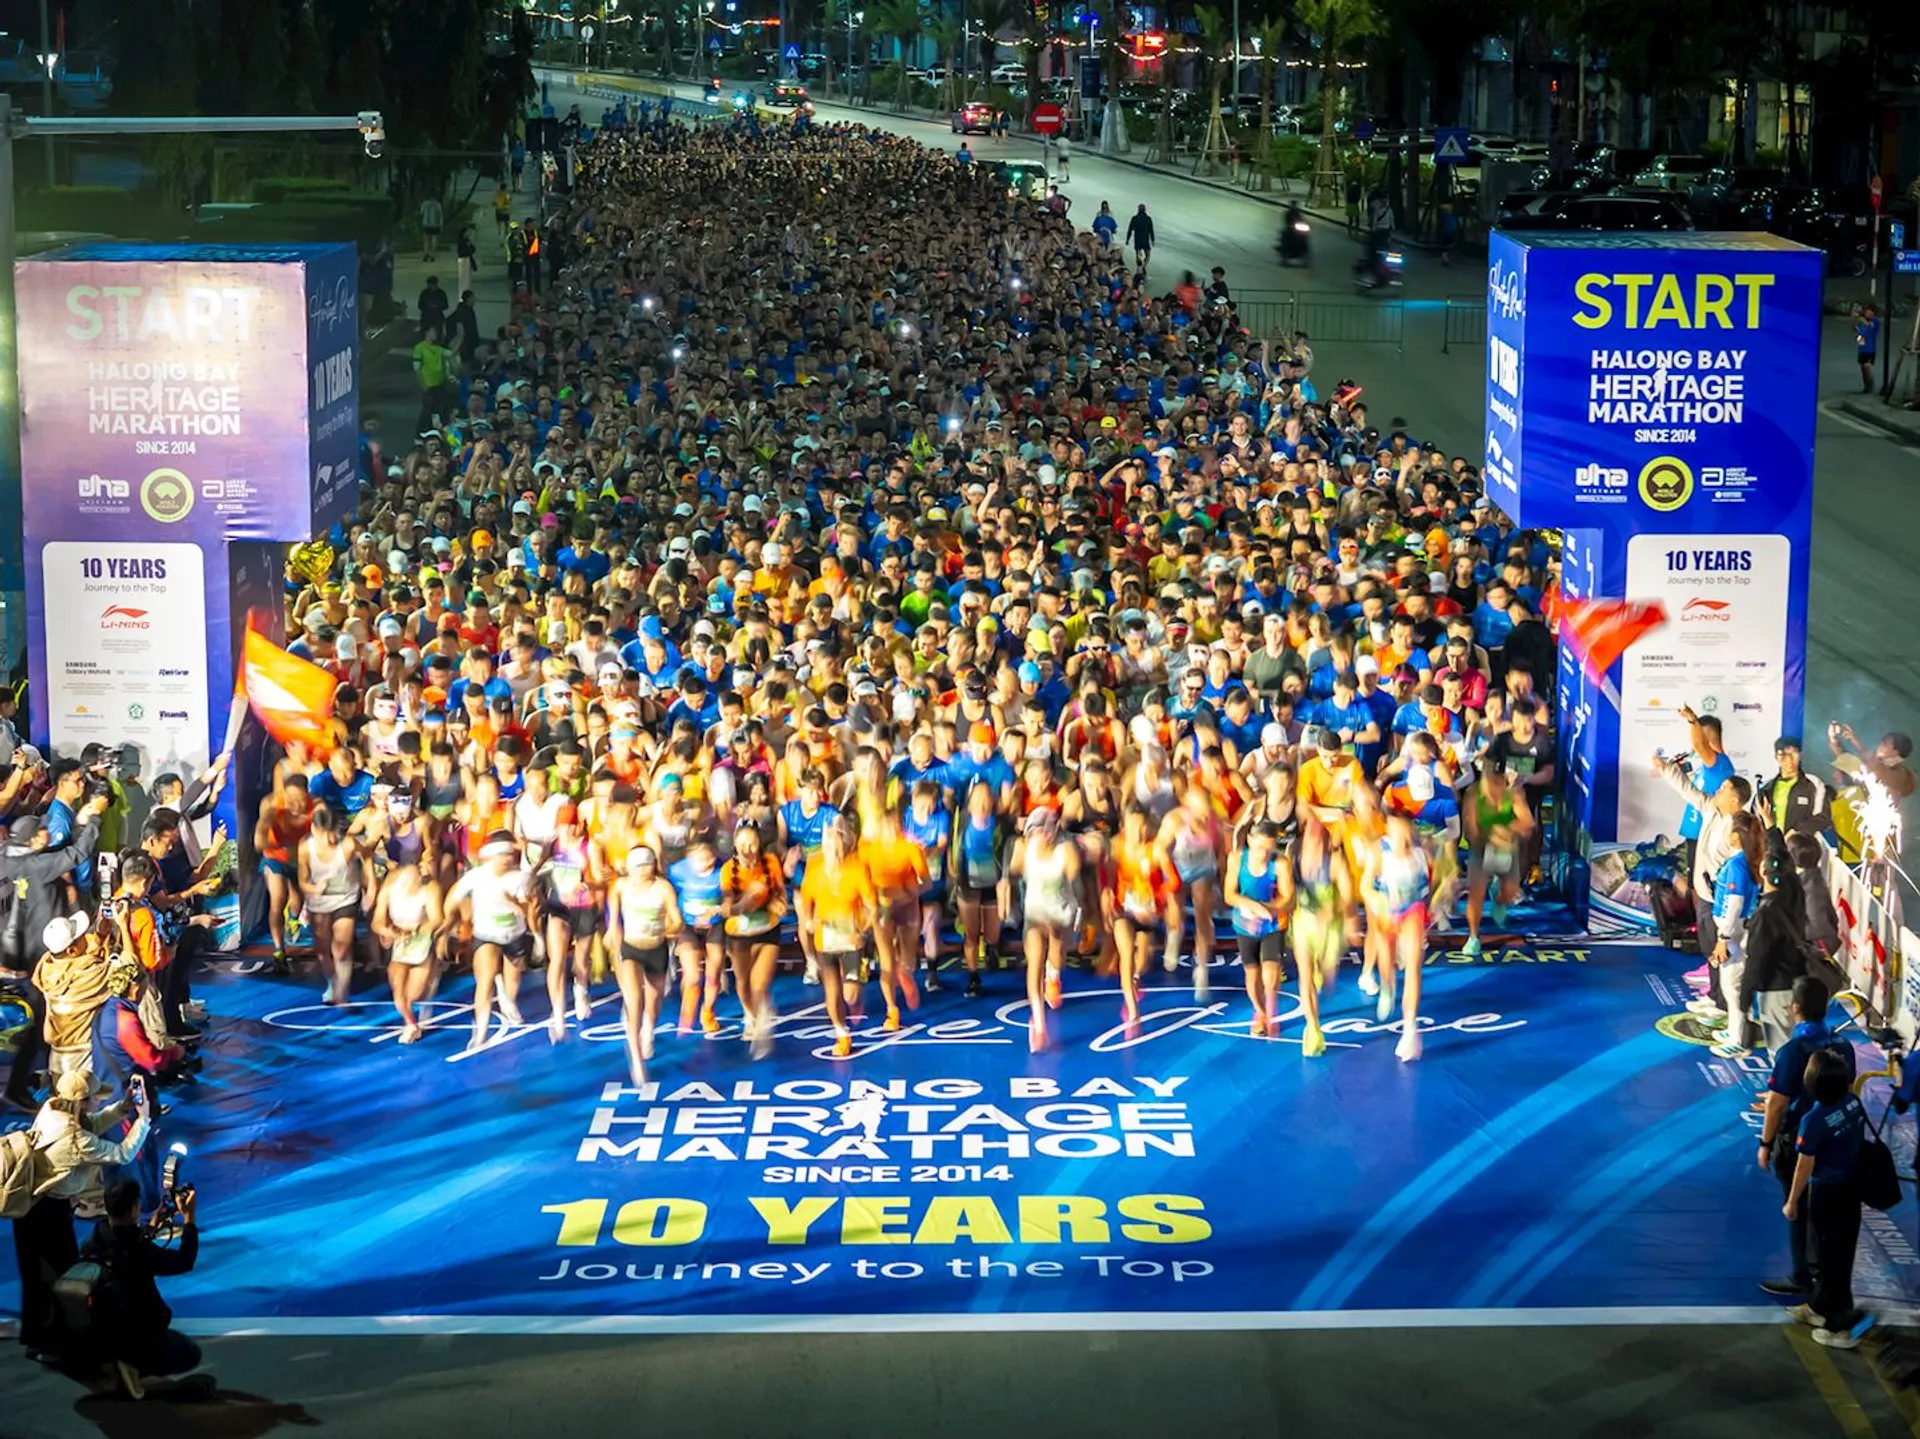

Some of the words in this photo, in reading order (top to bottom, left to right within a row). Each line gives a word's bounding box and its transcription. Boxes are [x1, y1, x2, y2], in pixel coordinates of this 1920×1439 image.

[1572, 272, 1775, 329] START
[65, 285, 262, 341] START
[1591, 350, 1692, 369] HALONG
[1698, 350, 1747, 369] BAY
[89, 362, 187, 381] HALONG
[195, 362, 240, 381] BAY
[1590, 374, 1744, 400] HERITAGE
[89, 386, 241, 412] HERITAGE
[1589, 401, 1743, 424] MARATHON
[89, 413, 241, 435] MARATHON
[1634, 429, 1669, 443] SINCE
[1670, 429, 1696, 443] 2014
[136, 441, 168, 454] SINCE
[169, 441, 196, 454] 2014
[80, 558, 103, 578] 10
[108, 558, 166, 579] YEARS
[1666, 551, 1687, 571] 10
[1693, 550, 1752, 571] YEARS
[83, 583, 119, 593] Journey
[121, 584, 131, 592] to
[133, 583, 148, 592] the
[150, 584, 166, 593] Top
[1667, 576, 1703, 586] Journey
[1717, 575, 1732, 584] the
[1733, 576, 1751, 586] Top
[101, 621, 149, 629] LI-NING
[600, 1078, 983, 1102] HALONG
[1009, 1076, 1190, 1098] BAY
[587, 1103, 1194, 1135] HERITAGE
[576, 1133, 1196, 1162] MARATHON
[762, 1166, 903, 1184] SINCE
[910, 1165, 1014, 1183] 2014
[540, 1198, 708, 1248] 10
[748, 1194, 1213, 1246] YEARS
[538, 1258, 831, 1284] Journey
[851, 1260, 919, 1279] to
[945, 1256, 1048, 1278] the
[1095, 1256, 1215, 1282] Top
